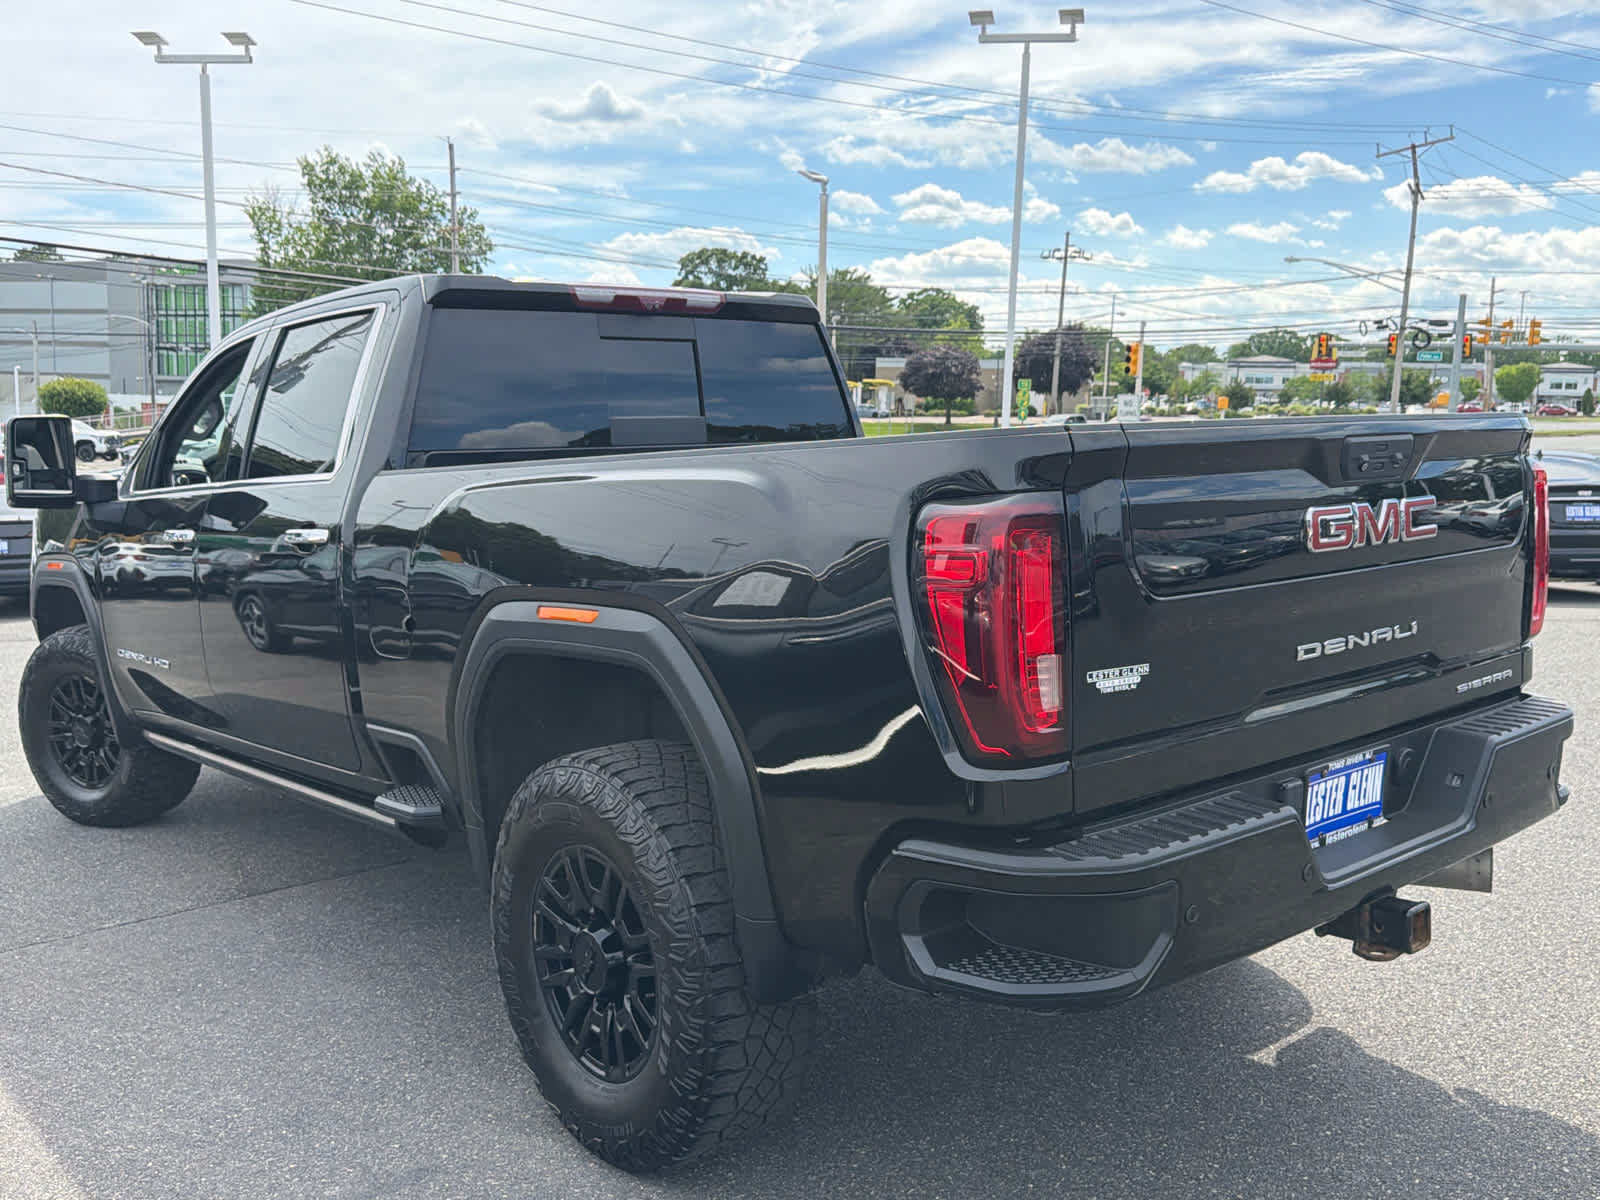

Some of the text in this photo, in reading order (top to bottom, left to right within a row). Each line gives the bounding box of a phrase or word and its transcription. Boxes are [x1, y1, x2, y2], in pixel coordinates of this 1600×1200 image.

[1306, 495, 1438, 552] GMC
[1296, 620, 1418, 661] DENALI
[1088, 664, 1149, 681] LESTER GLENN
[1456, 669, 1513, 693] SIERRA
[1305, 764, 1384, 826] LESTER GLENN
